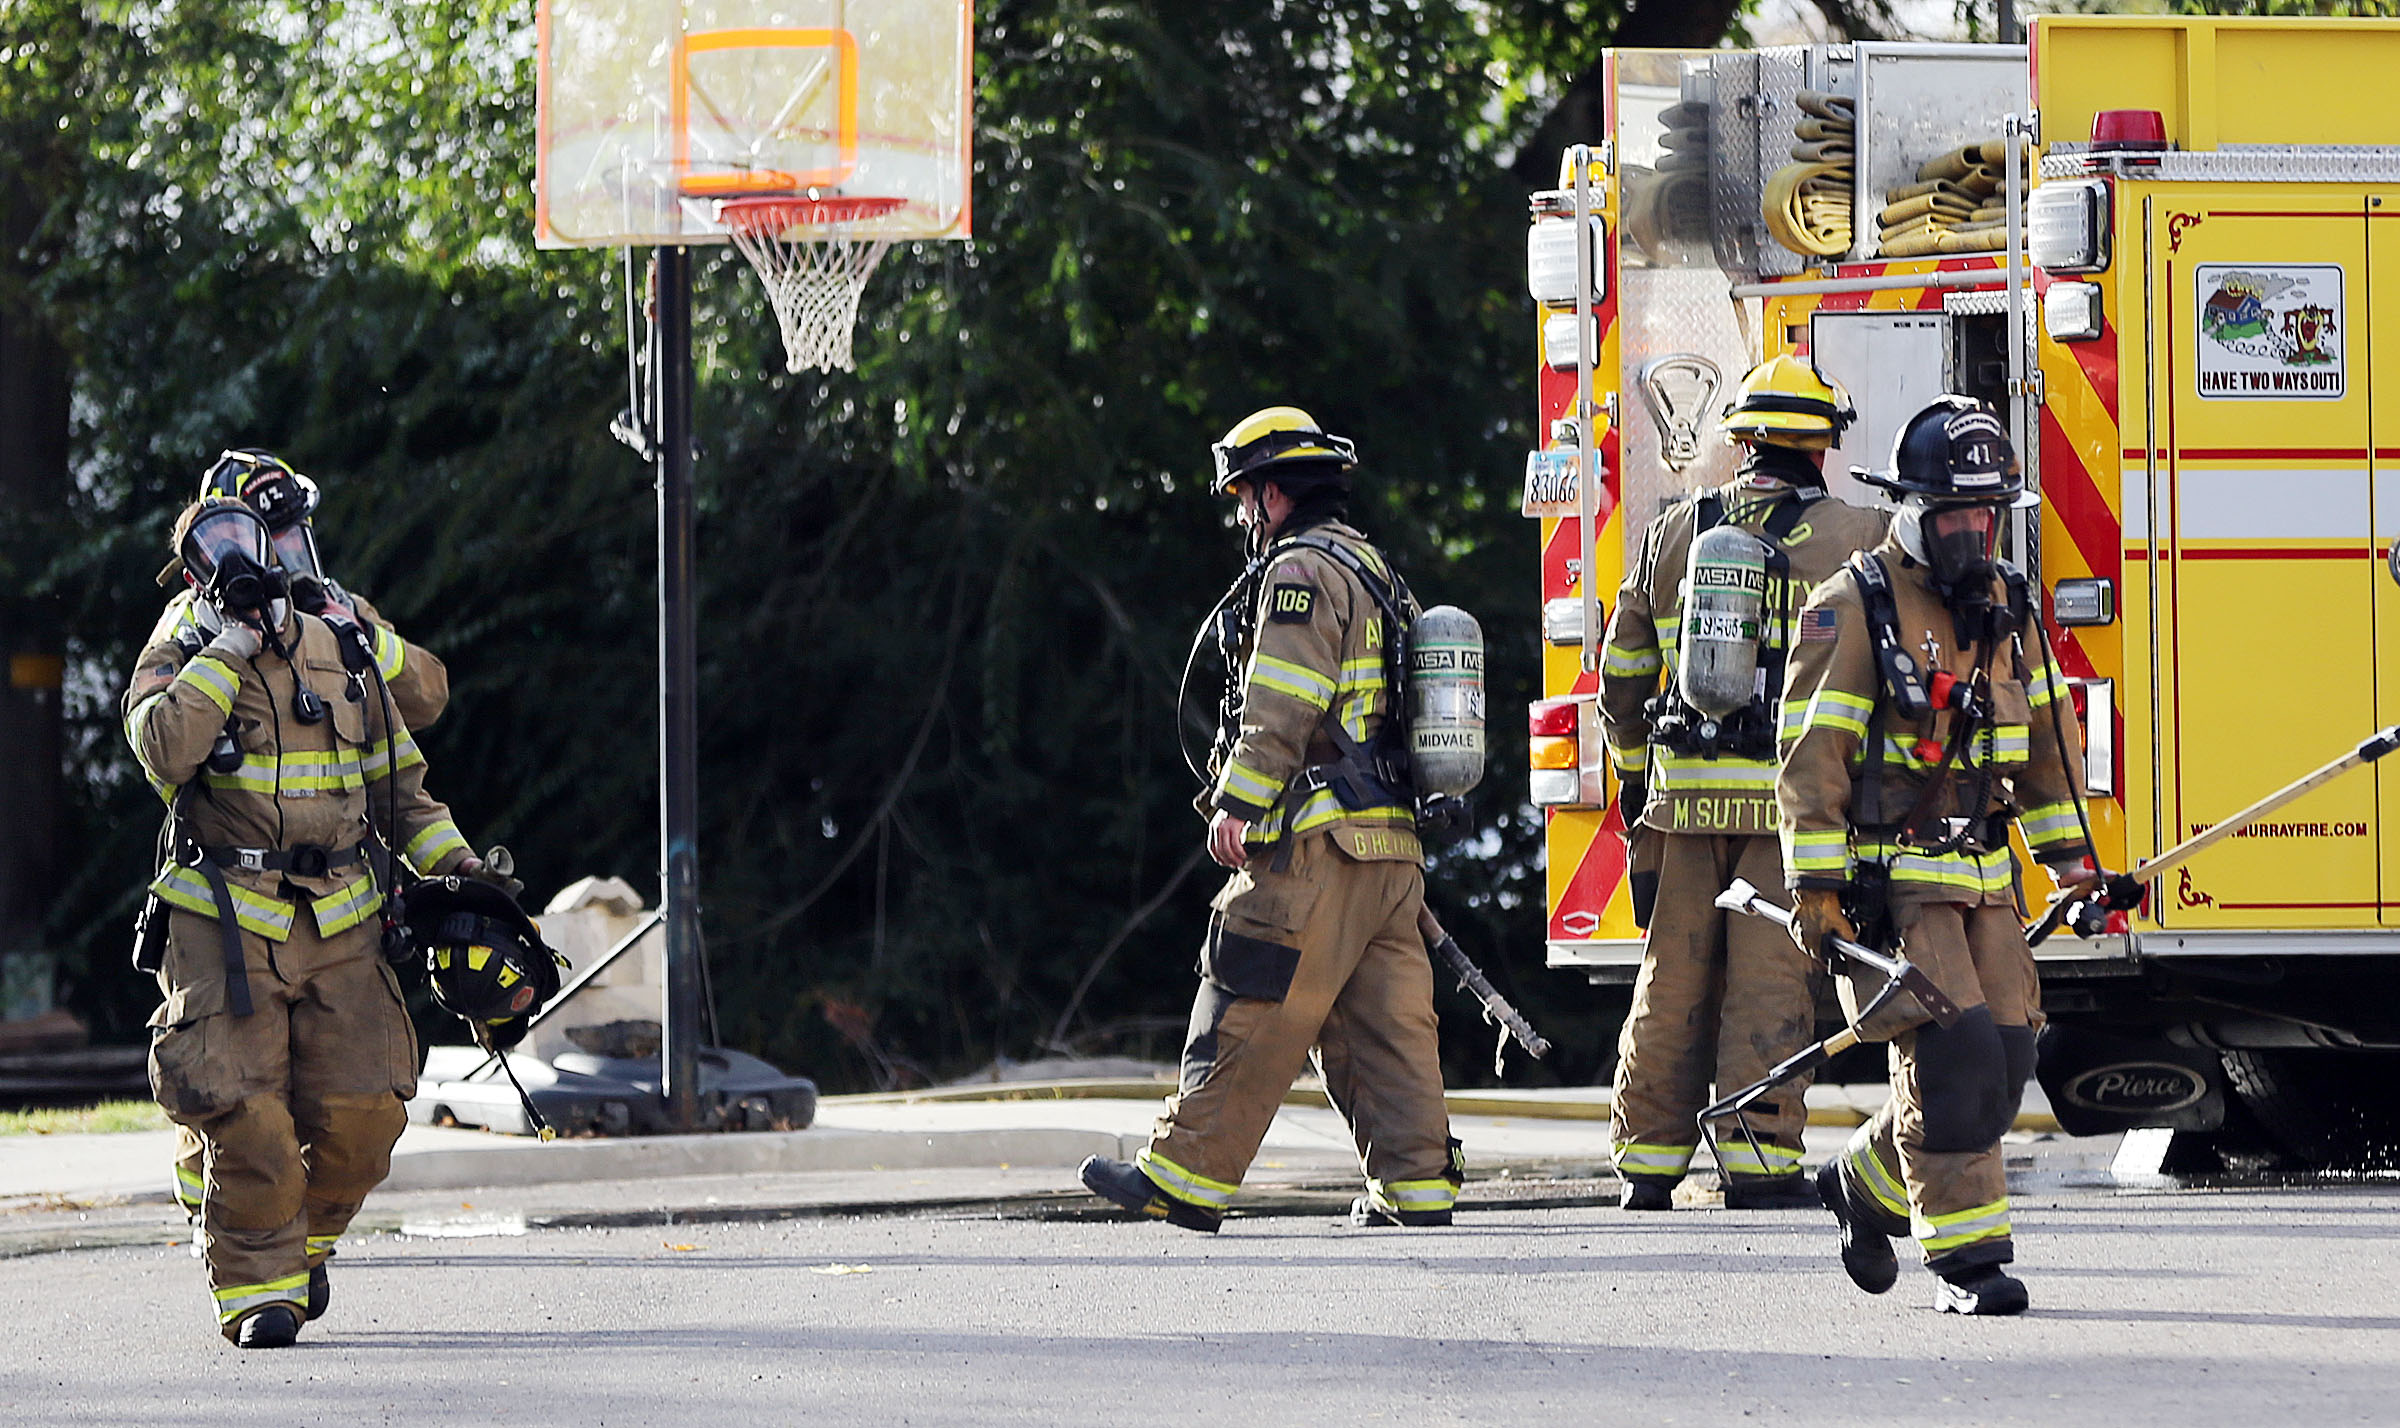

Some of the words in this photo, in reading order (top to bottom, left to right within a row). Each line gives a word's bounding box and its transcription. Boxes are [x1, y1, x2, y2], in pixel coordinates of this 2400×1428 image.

[2202, 371, 2237, 390] HAVE
[2240, 371, 2270, 390] TWO
[2273, 371, 2308, 391] WAYS
[2311, 371, 2340, 391] OUT!
[1966, 444, 1991, 466] 41
[1530, 473, 1577, 503] 83066
[1695, 568, 1739, 587] MSA
[1276, 589, 1311, 613] 106
[1411, 651, 1454, 669] MSA
[1418, 733, 1474, 748] MIDVALE
[1673, 797, 1689, 830] M
[1354, 832, 1367, 856] G
[2096, 1073, 2180, 1101] Pierce
